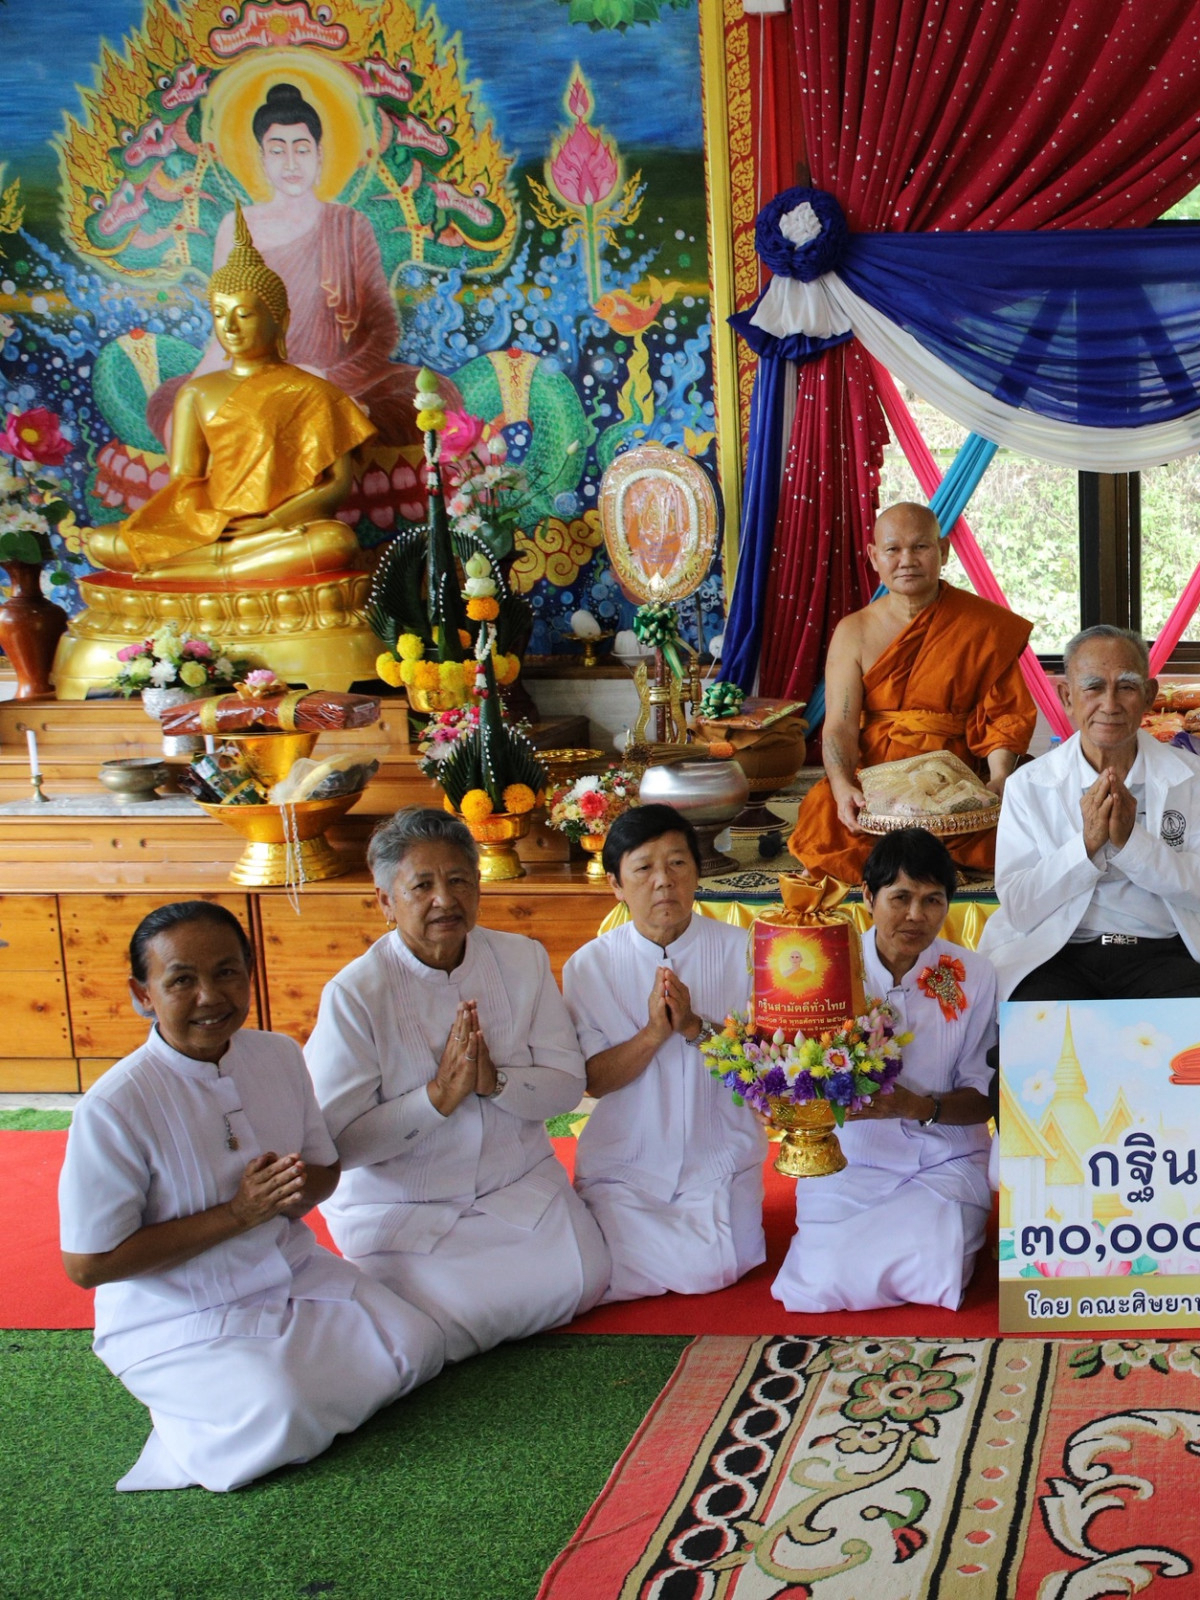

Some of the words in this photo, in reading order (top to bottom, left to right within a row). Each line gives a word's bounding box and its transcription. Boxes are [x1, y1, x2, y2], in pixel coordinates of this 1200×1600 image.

[758, 998, 846, 1013] กฐินสามัคคีทั่วไทย
[1026, 1293, 1070, 1316] โดย
